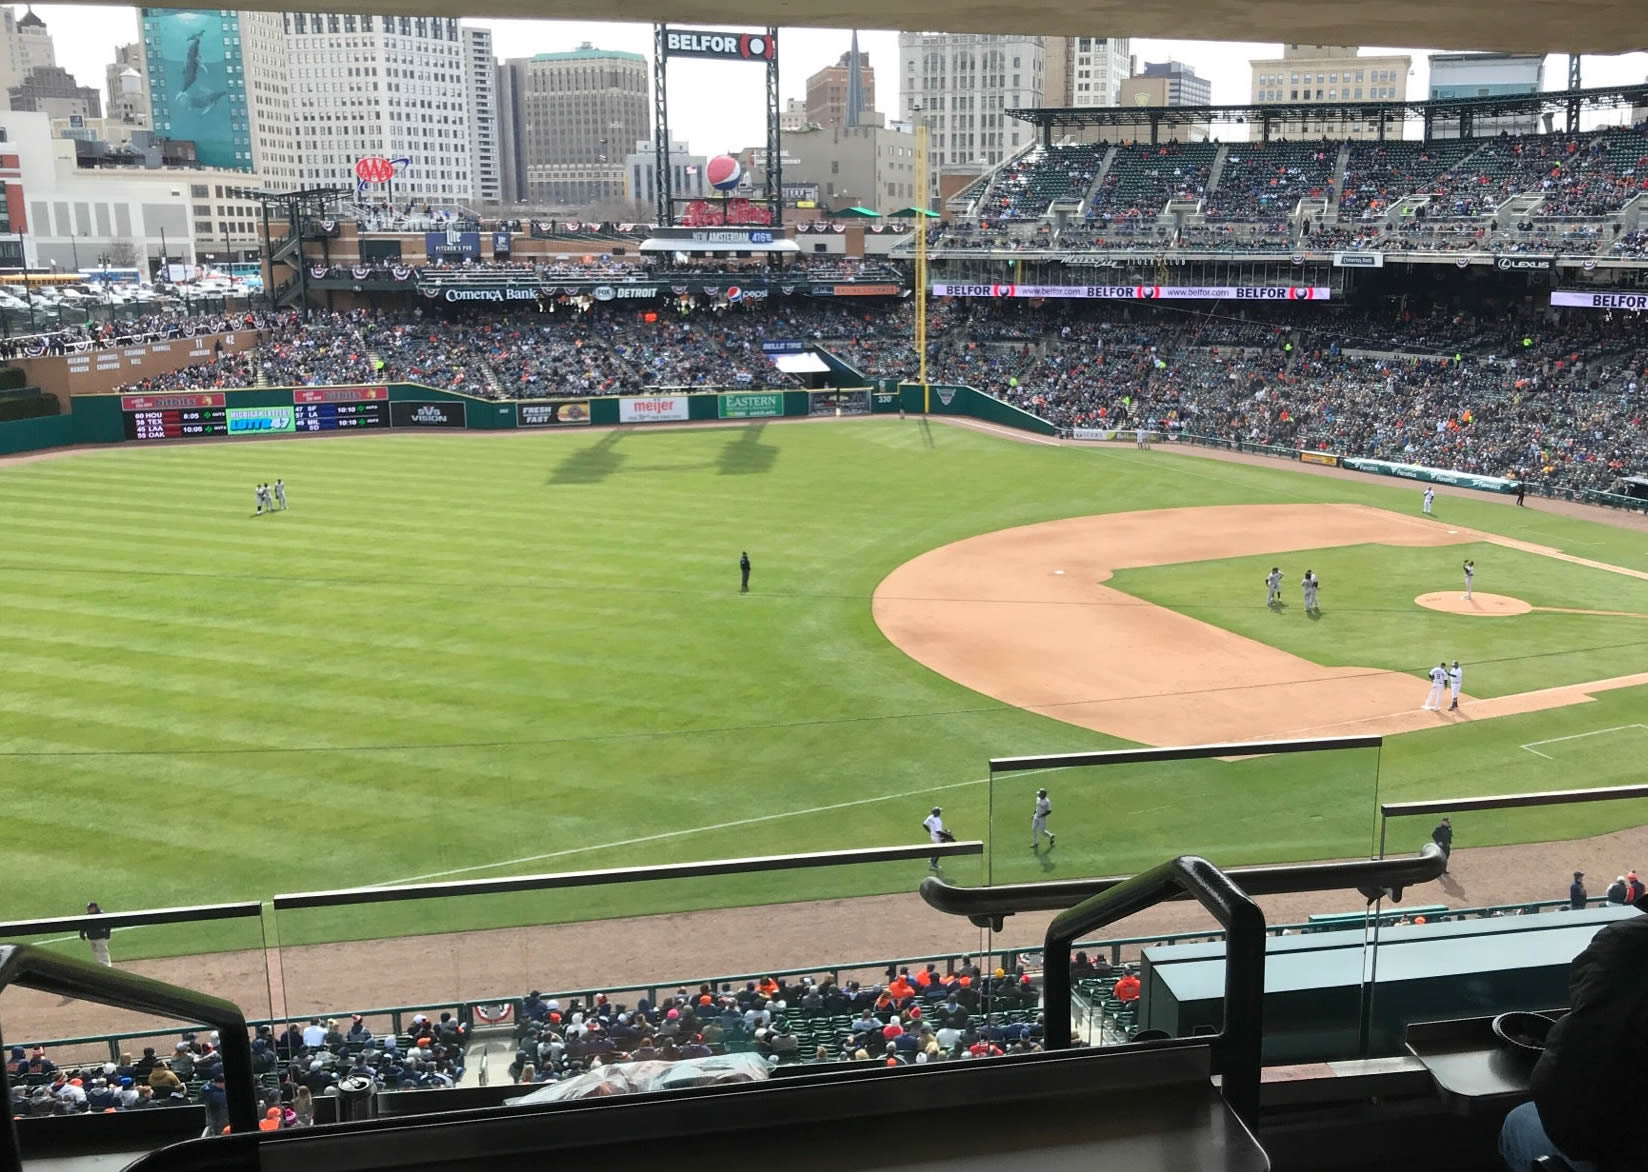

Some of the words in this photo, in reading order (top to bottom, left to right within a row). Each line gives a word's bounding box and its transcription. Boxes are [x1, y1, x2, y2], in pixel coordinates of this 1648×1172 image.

[668, 34, 737, 53] BELFOR
[358, 159, 392, 182] AAA
[692, 231, 708, 240] NEW
[708, 231, 750, 241] AMSTERDAM
[1163, 257, 1186, 266] CLUB
[1511, 260, 1550, 269] LEXUS
[506, 288, 537, 300] Bank
[617, 287, 658, 298] DETROIT
[742, 289, 769, 299] pepsi
[946, 285, 991, 296] BELFOR
[1022, 286, 1081, 296] www.belfor.com
[1087, 287, 1134, 297] BELFOR
[1167, 287, 1230, 297] www.belfor.com
[1236, 288, 1286, 298] BELFOR
[1592, 294, 1647, 308] BELFOR
[633, 400, 675, 414] meijer
[726, 396, 777, 408] EASTERN
[522, 406, 552, 414] FRESH
